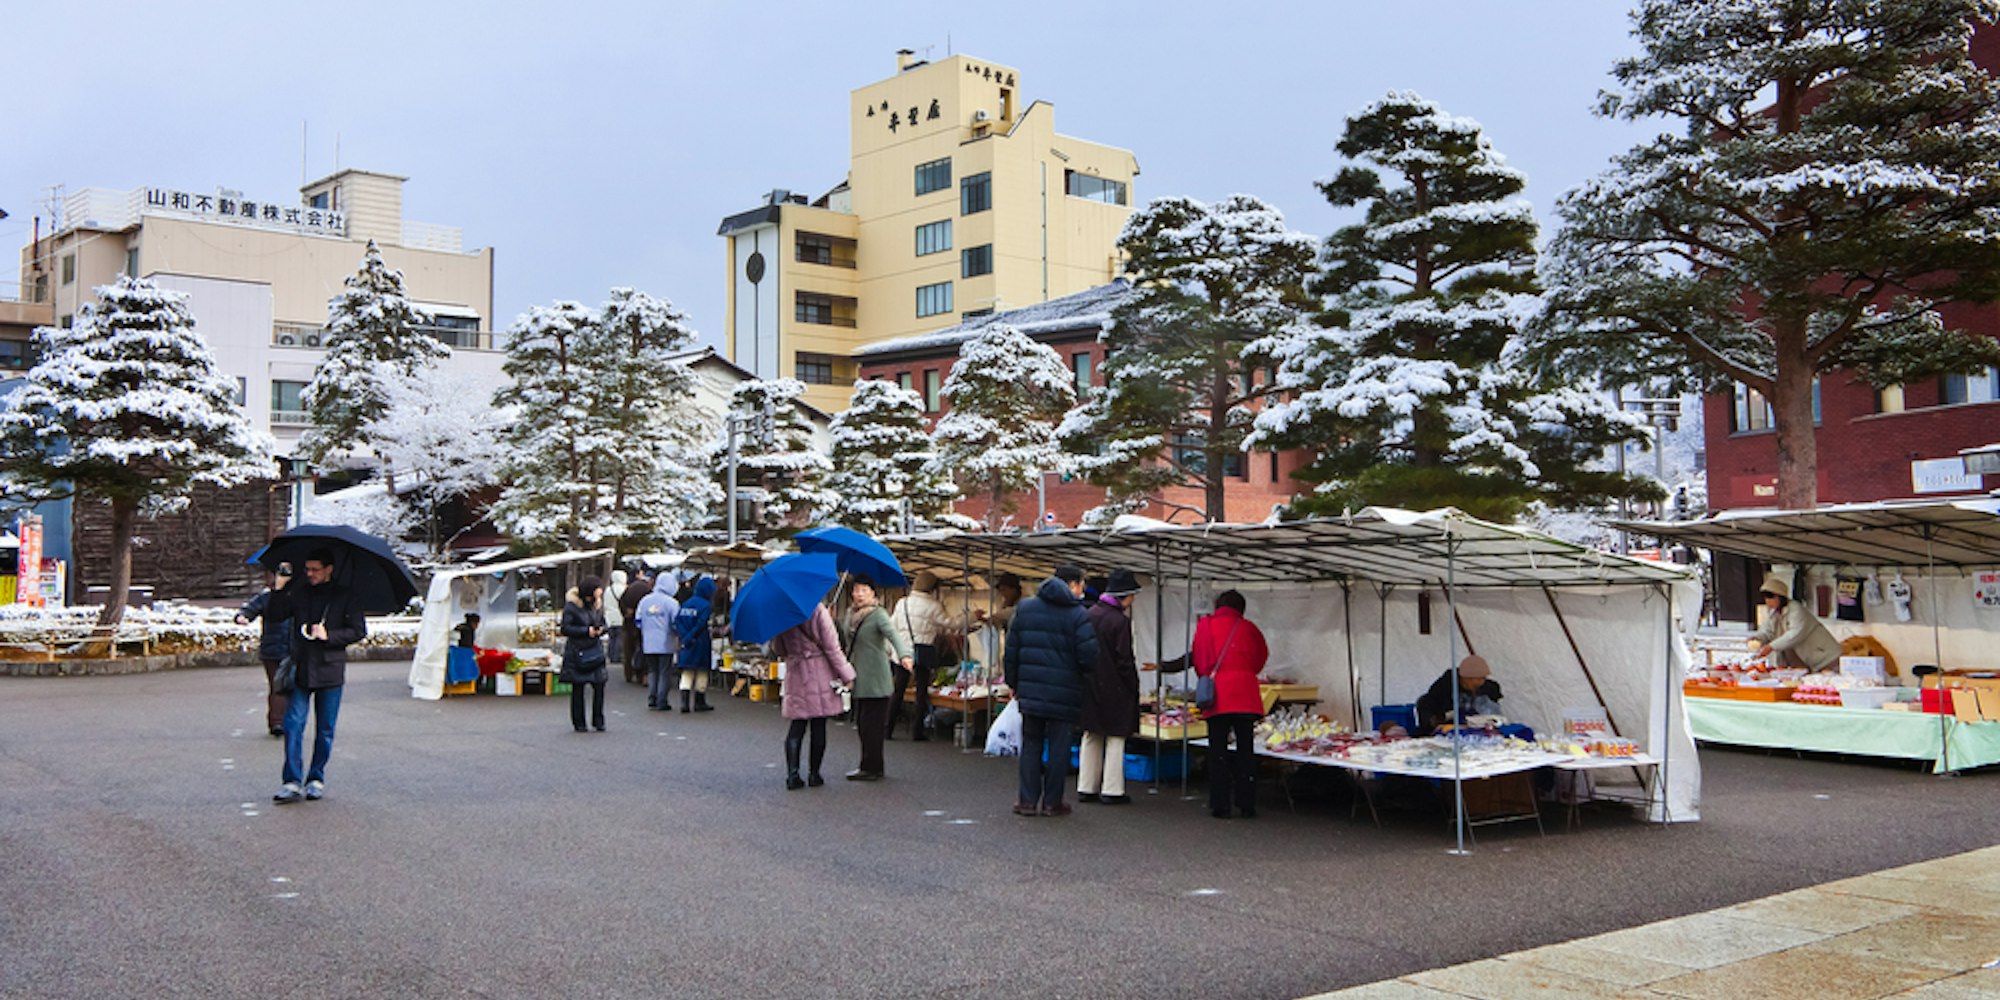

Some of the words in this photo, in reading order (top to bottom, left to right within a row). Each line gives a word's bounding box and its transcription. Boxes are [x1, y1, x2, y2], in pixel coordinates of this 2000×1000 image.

[147, 189, 342, 230] 山和不動産株式会社
